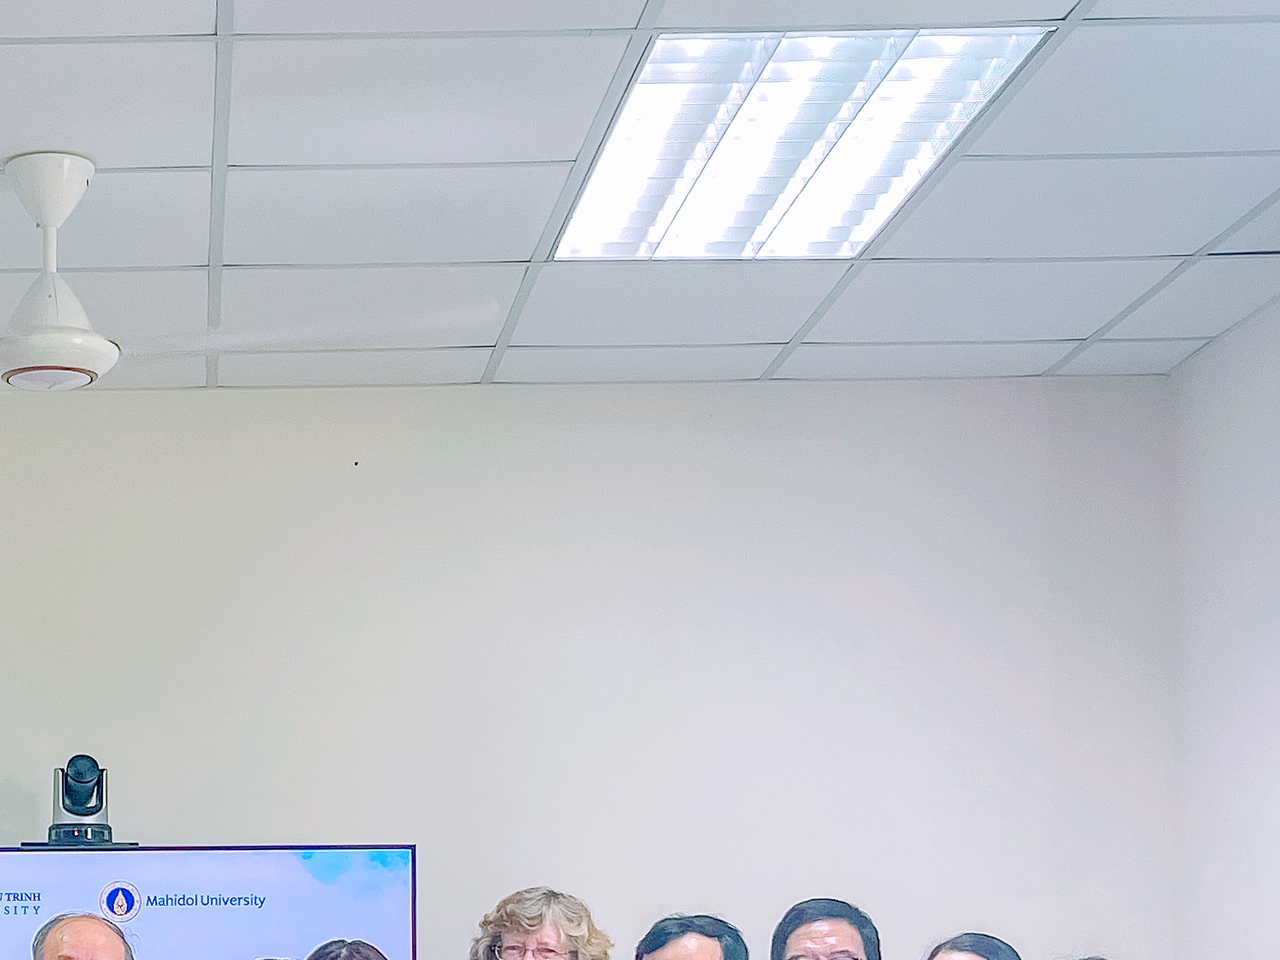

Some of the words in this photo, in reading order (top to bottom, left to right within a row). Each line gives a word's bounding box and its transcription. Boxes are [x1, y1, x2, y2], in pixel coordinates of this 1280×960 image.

[5, 893, 41, 902] TRINH
[146, 894, 198, 907] Mahidol
[201, 893, 266, 908] University
